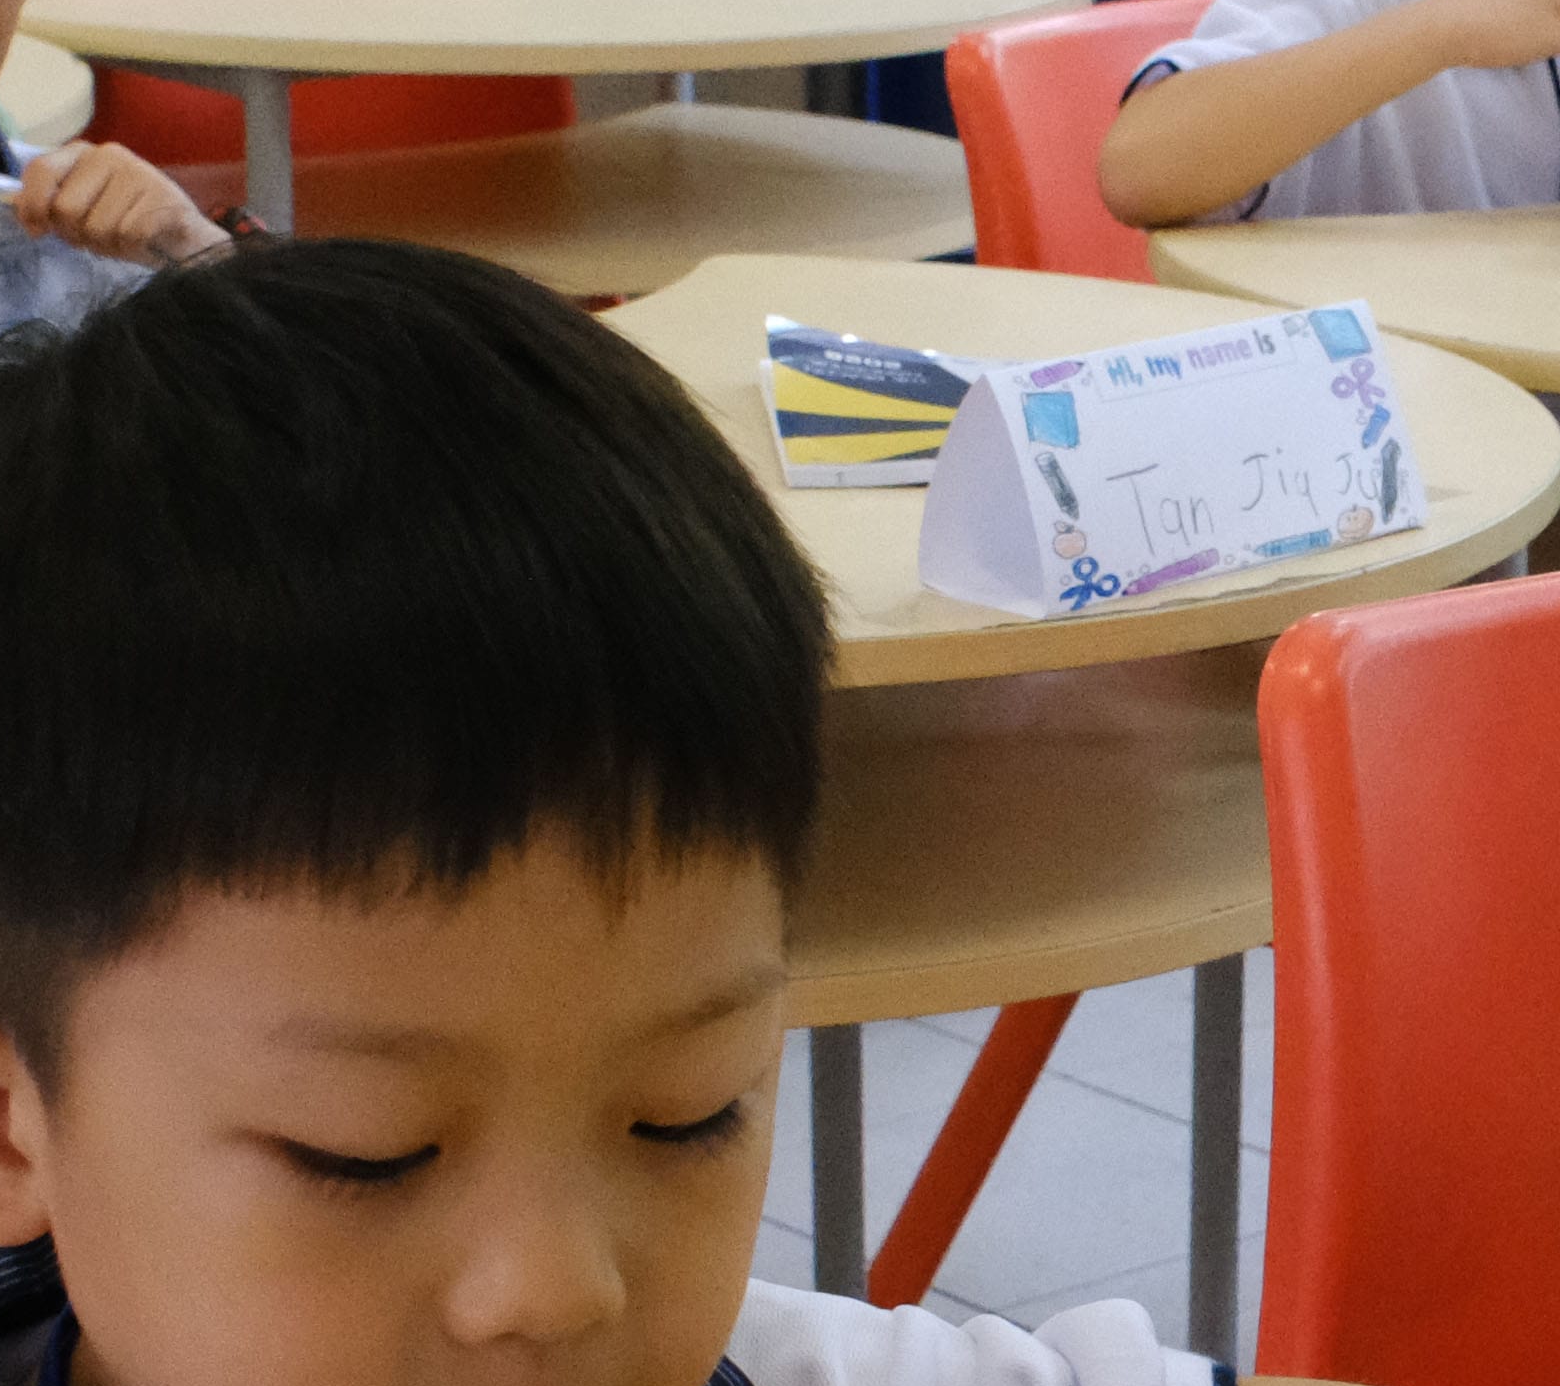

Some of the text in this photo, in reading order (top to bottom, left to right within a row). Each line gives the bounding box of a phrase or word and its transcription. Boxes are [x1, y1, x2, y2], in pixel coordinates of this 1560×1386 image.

[1144, 355, 1183, 380] my
[1186, 338, 1253, 371] name
[1252, 328, 1277, 355] is
[1105, 462, 1216, 558] Tan
